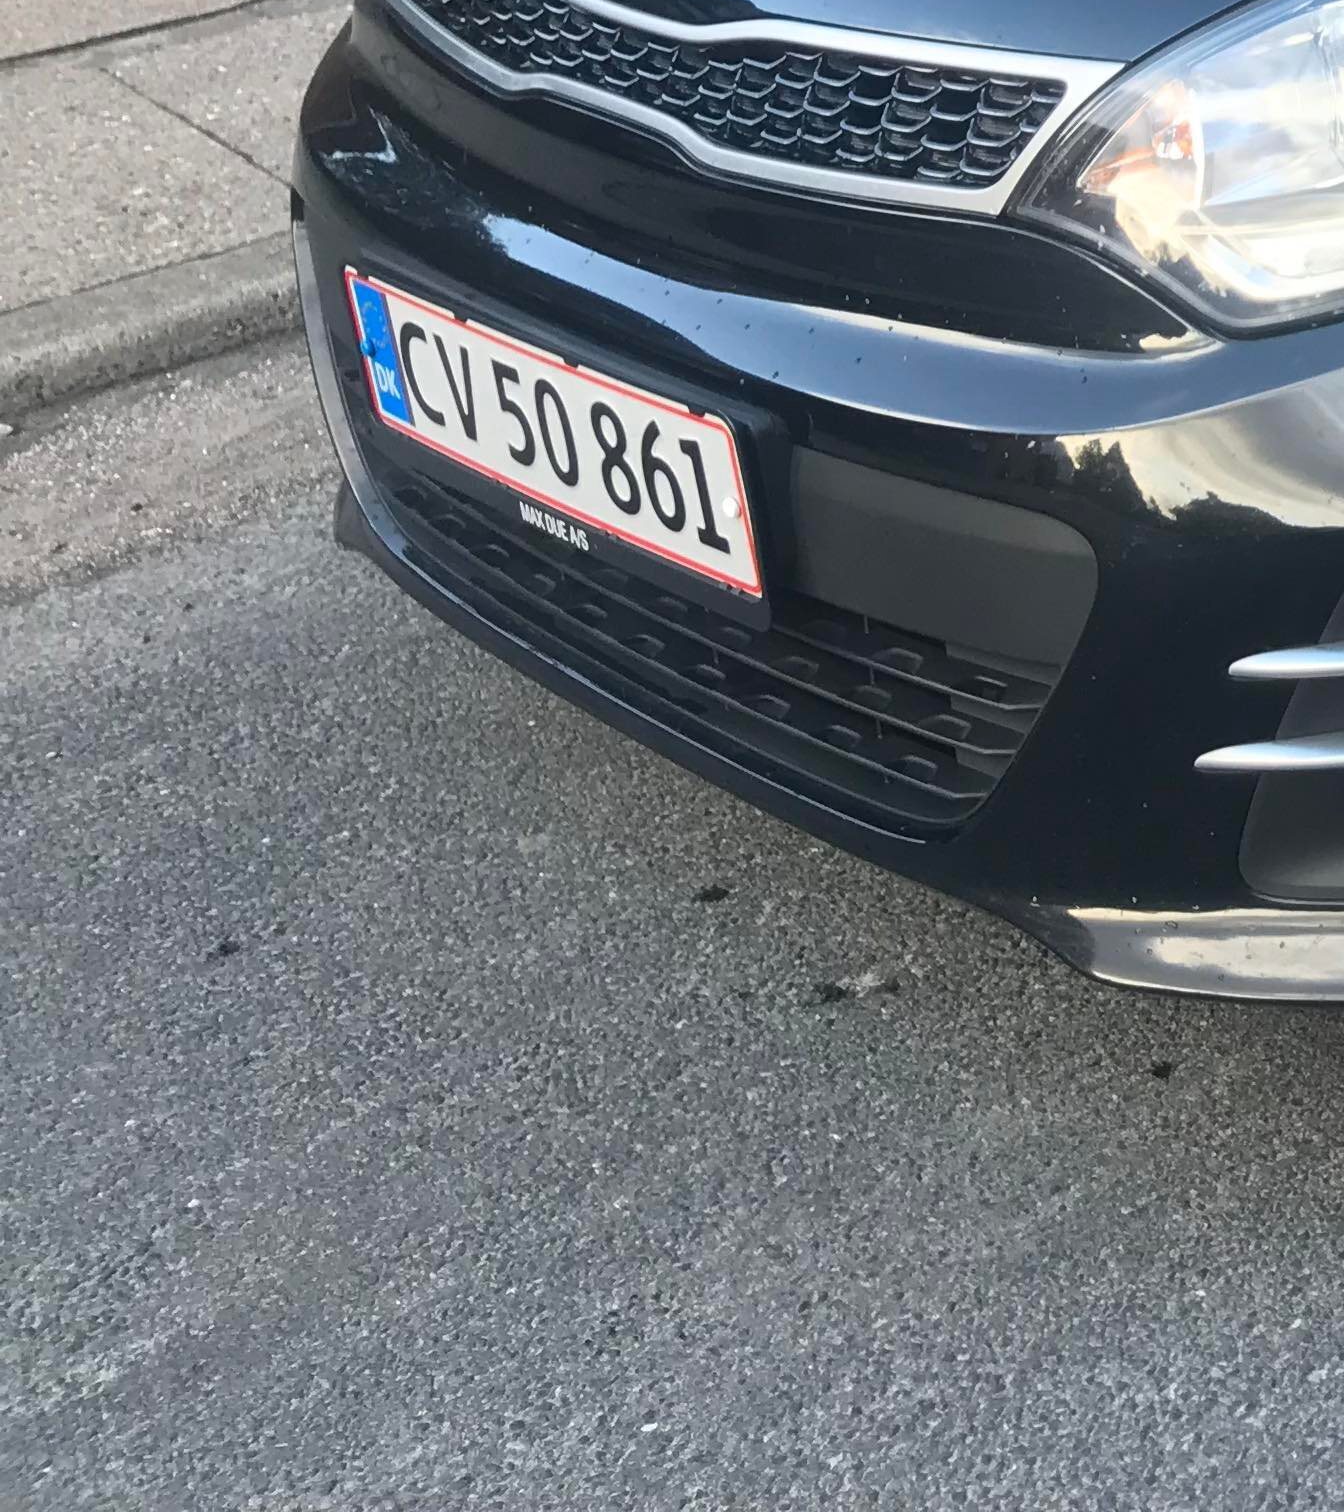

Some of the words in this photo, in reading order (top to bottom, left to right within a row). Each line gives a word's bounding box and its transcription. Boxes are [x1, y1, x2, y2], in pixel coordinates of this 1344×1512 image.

[374, 361, 401, 399] DK
[399, 321, 478, 442] CV
[490, 359, 580, 488] 50
[589, 400, 731, 555] 861
[519, 500, 546, 531] MAX
[544, 512, 569, 542] DUE
[569, 524, 590, 551] A/S
